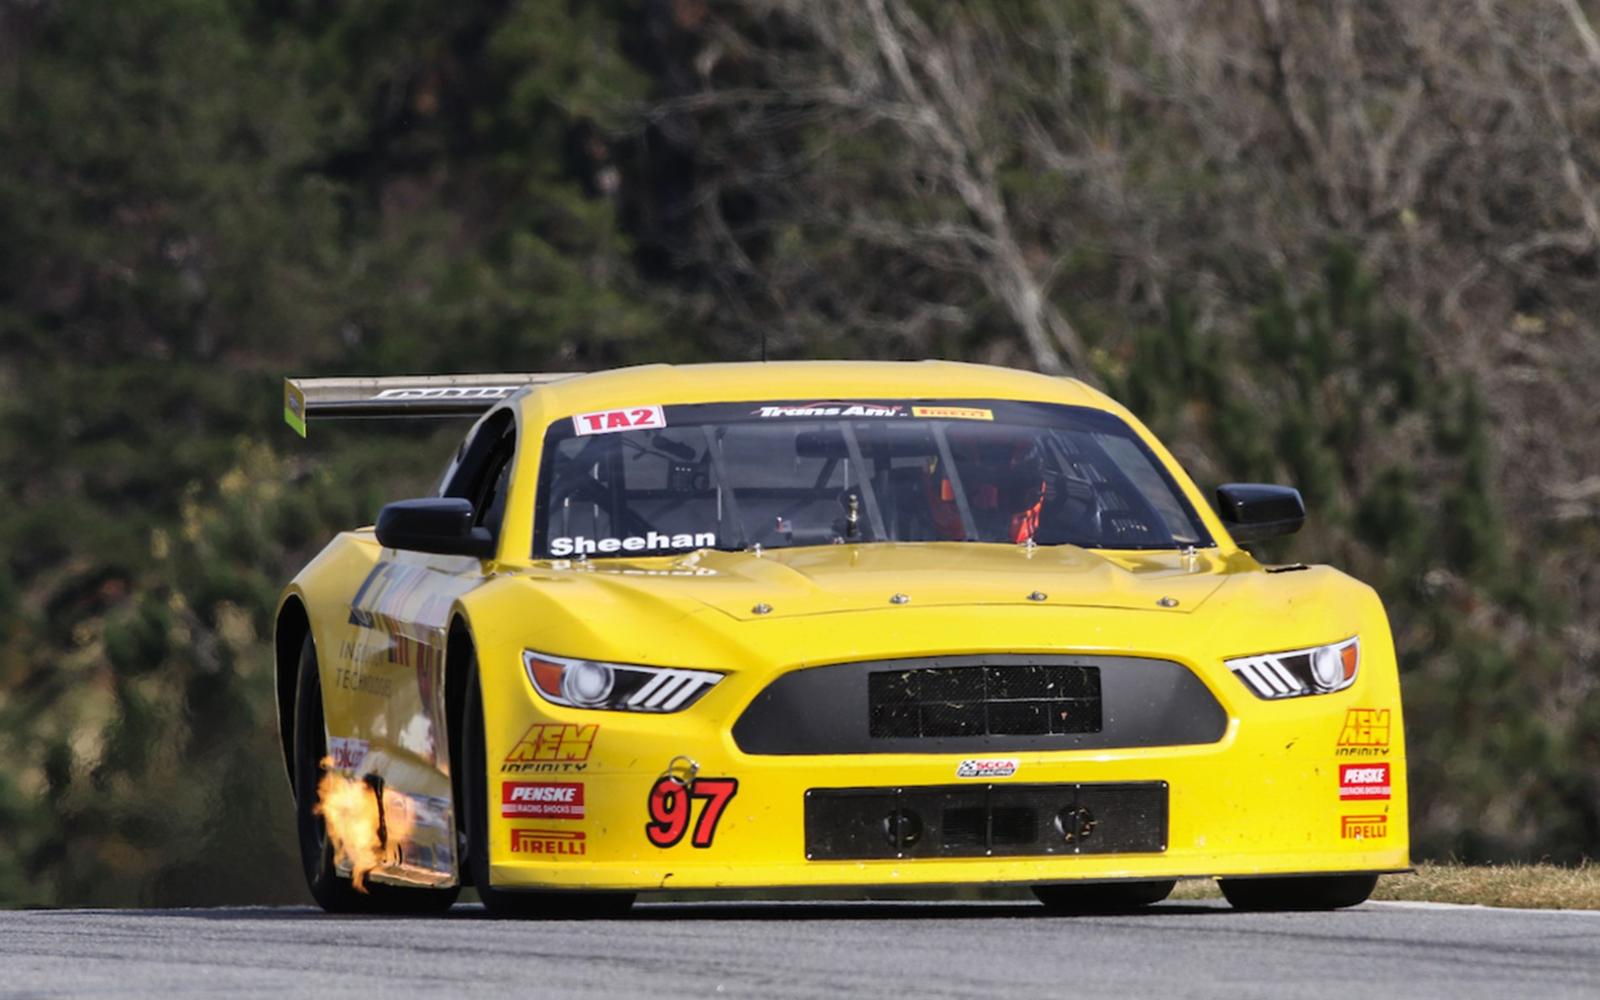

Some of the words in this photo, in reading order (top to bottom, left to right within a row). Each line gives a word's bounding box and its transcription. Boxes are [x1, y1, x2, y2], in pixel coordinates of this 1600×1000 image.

[583, 408, 656, 431] TA2
[550, 531, 716, 557] Sheehan
[1337, 709, 1390, 746] AEM
[504, 724, 599, 762] AEM
[1335, 748, 1389, 756] INFINITY
[501, 763, 587, 772] INFINITY
[510, 787, 577, 802] PENSKE
[645, 775, 739, 849] 97
[1340, 815, 1388, 839] PIRELLI
[510, 828, 587, 856] PIRELLI
